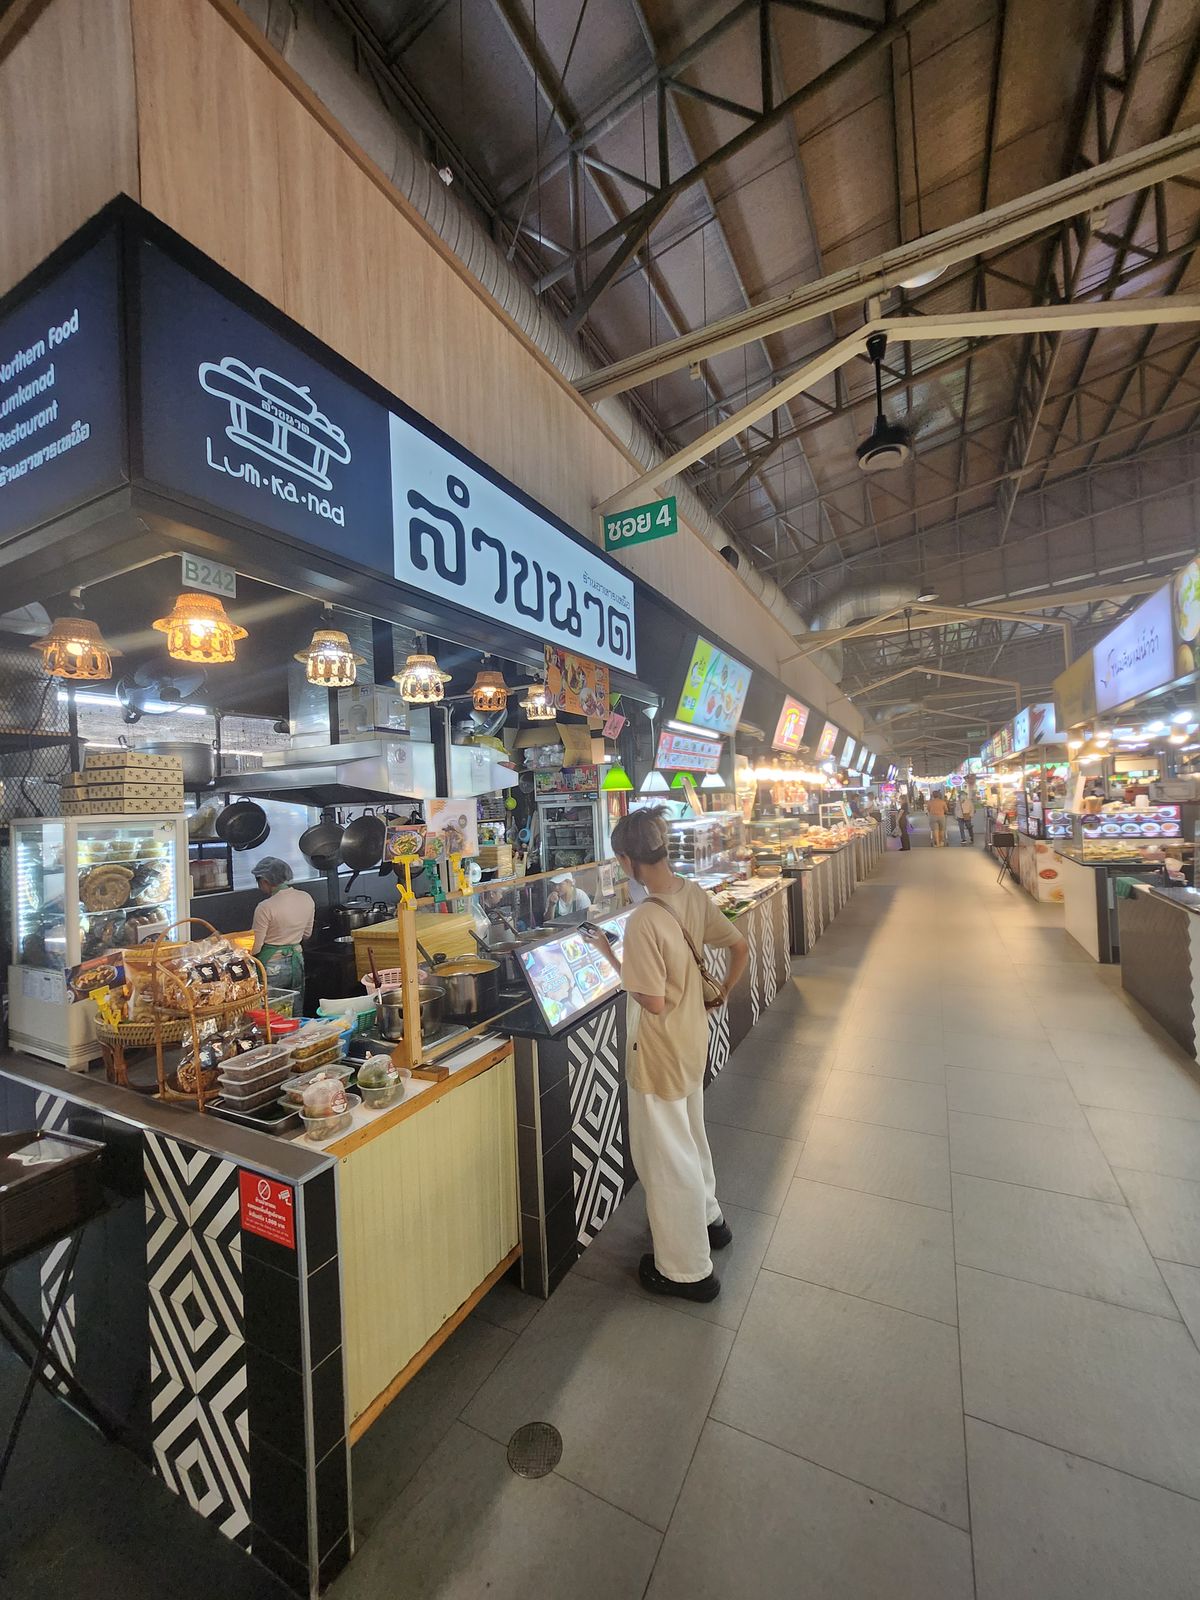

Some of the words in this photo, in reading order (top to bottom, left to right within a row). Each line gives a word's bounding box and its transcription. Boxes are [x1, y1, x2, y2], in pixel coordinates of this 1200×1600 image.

[48, 308, 79, 349] Food
[0, 399, 58, 453] Restaurant
[607, 512, 652, 542] ซอย
[655, 504, 672, 528] 4
[185, 558, 235, 592] B242
[407, 475, 631, 661] ลำขนาด
